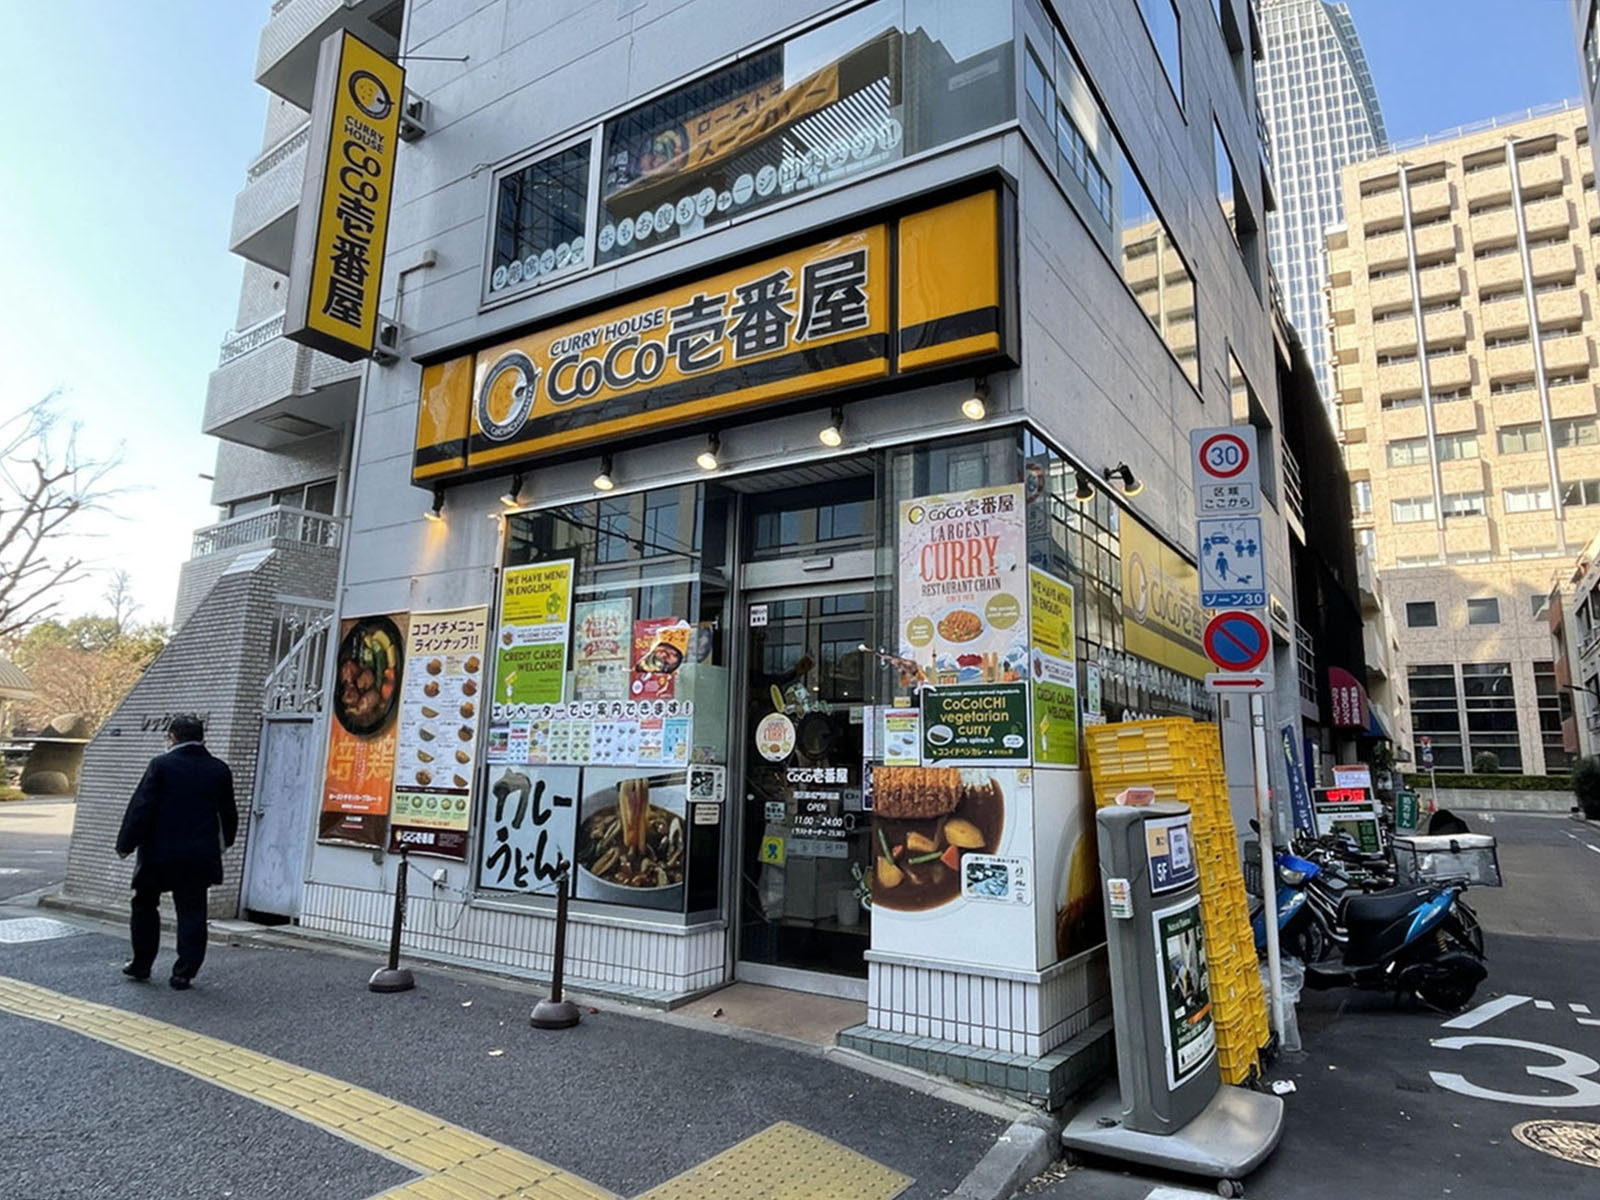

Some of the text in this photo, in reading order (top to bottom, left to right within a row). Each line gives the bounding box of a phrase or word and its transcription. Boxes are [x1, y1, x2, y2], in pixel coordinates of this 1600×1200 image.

[346, 115, 385, 143] CURRY
[344, 124, 384, 155] HOUSE
[322, 140, 382, 329] CoCo壱番屋
[546, 249, 869, 405] CoCo壱番屋
[550, 308, 664, 357] CURRY HOUSE
[1211, 446, 1239, 466] 30
[928, 494, 1014, 521] CoCo壱番屋
[1204, 497, 1250, 509] ここから
[931, 519, 989, 543] LARGEST
[921, 535, 999, 582] CURRY
[507, 569, 568, 585] WE HAVE MENU
[507, 587, 514, 596] IN
[921, 576, 1001, 597] RESTAURANT CHAIN
[1031, 579, 1042, 594] WE
[412, 620, 484, 636] ココイチメニュー
[415, 636, 479, 652] ラインナップ!!
[504, 649, 562, 662] CREDIT CARDS
[942, 697, 1006, 711] CoCoICHI
[939, 709, 1009, 725] vegetarian
[957, 724, 991, 737] curry
[786, 768, 848, 784] CoCo壱番屋
[493, 768, 573, 829] カレー
[806, 803, 827, 811] OPEN
[486, 828, 570, 888] うどん
